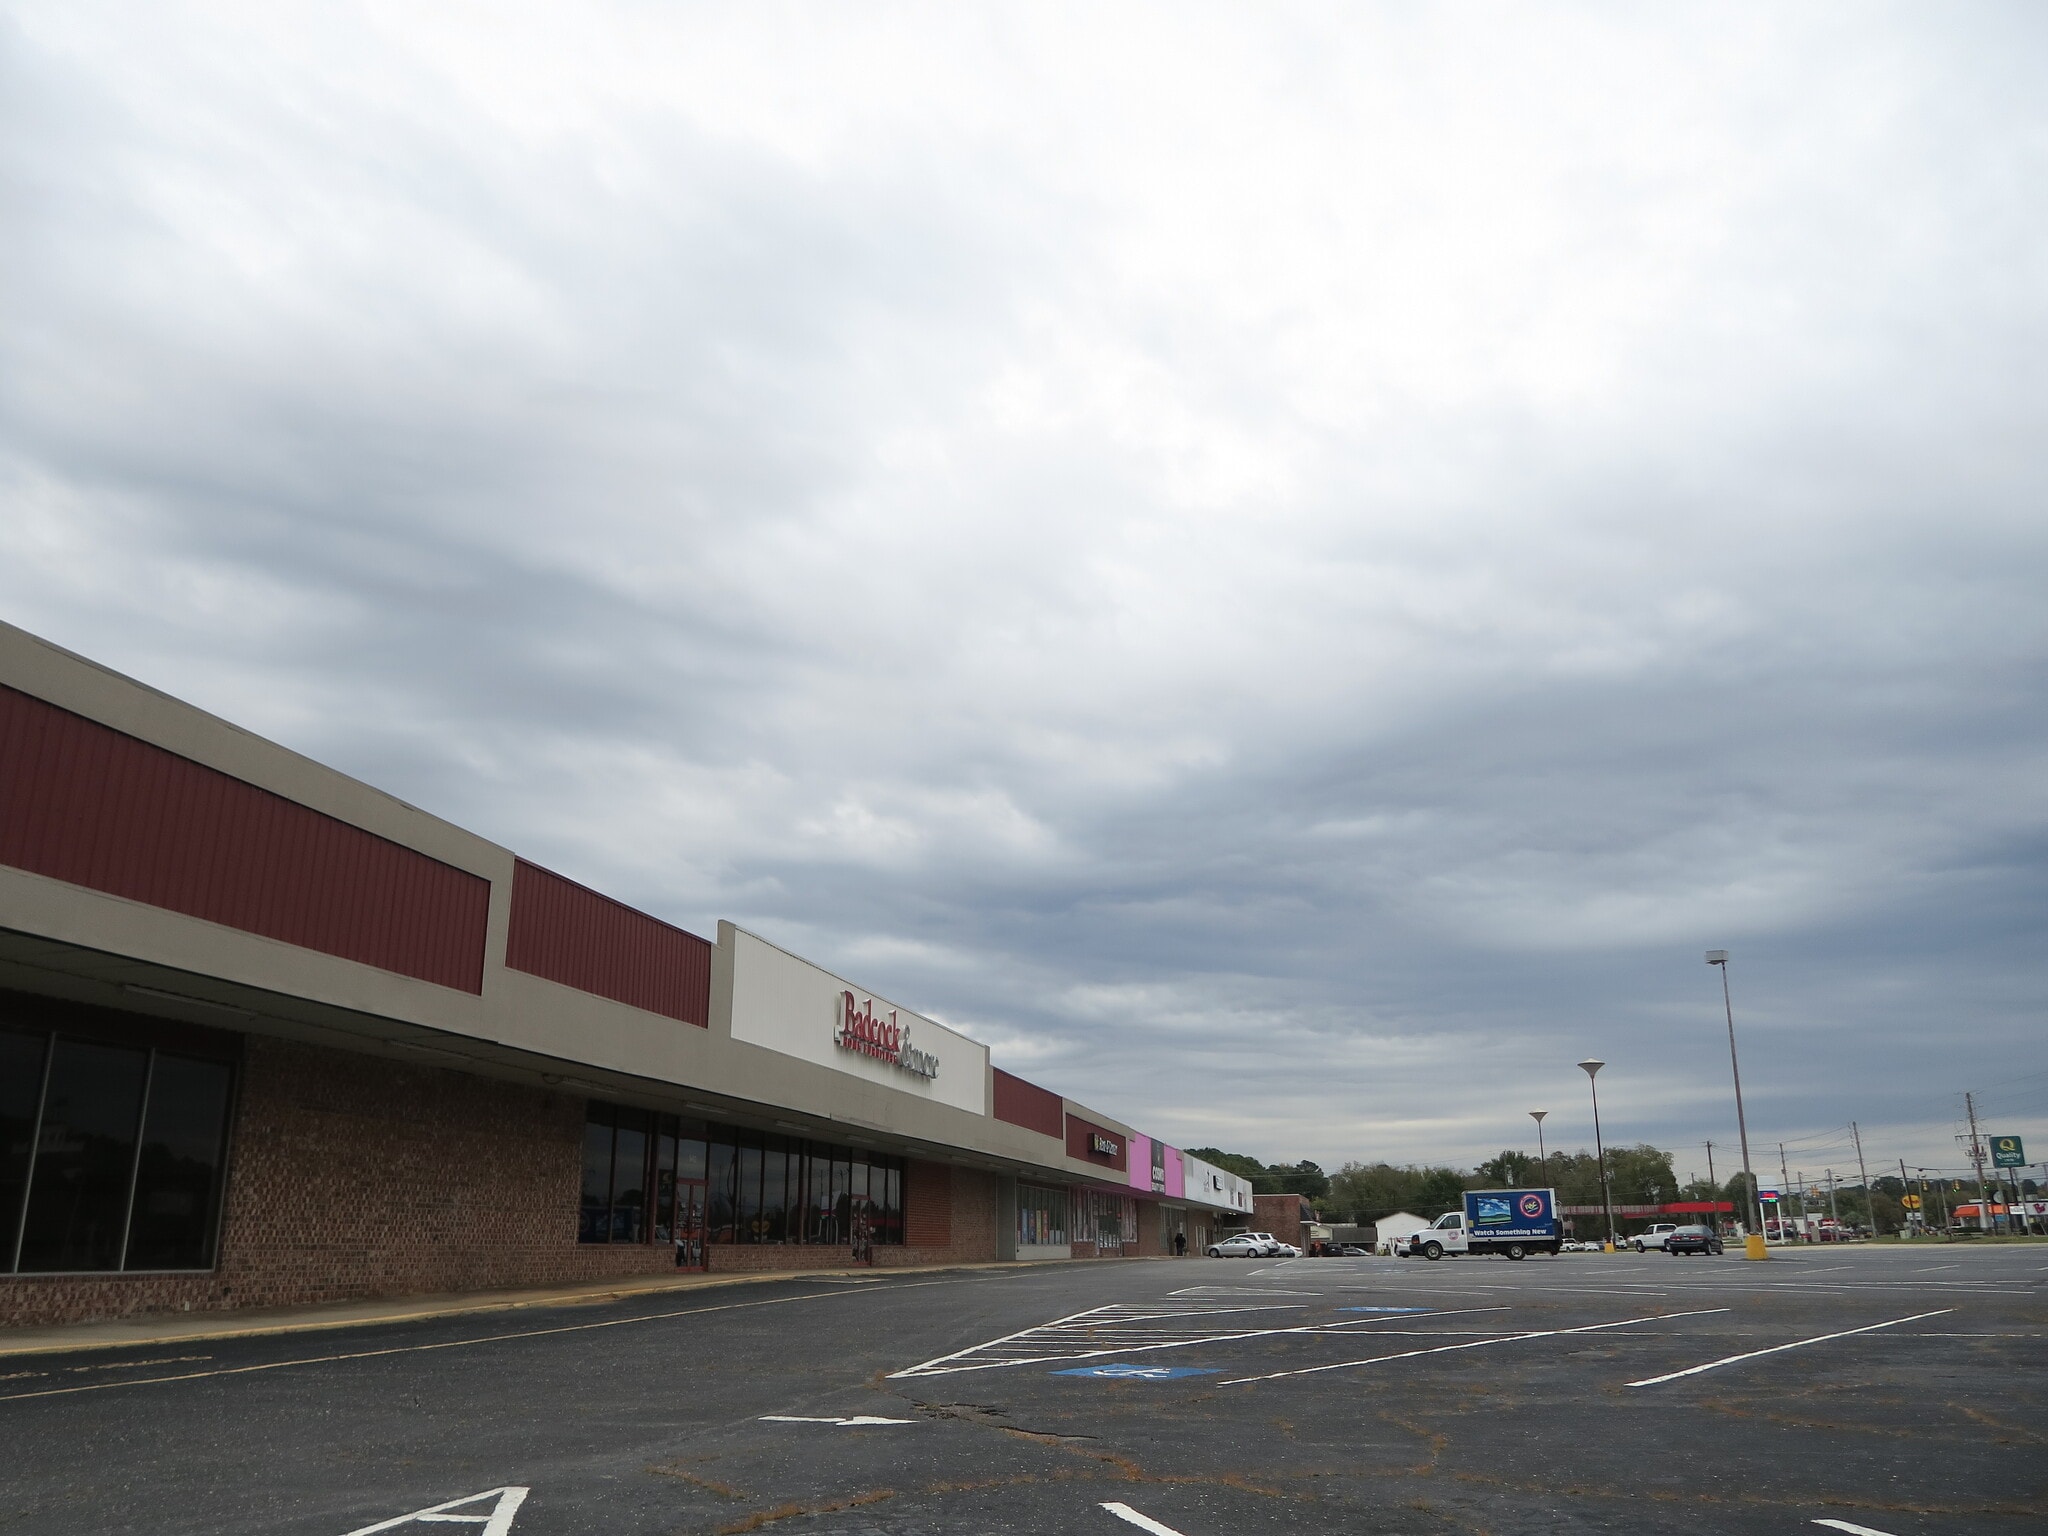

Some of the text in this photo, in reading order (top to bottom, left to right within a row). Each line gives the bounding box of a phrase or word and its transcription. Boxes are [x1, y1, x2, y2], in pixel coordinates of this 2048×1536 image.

[840, 990, 900, 1053] Badcock
[1995, 1151, 2021, 1160] Quality
[1495, 1228, 1531, 1236] Something
